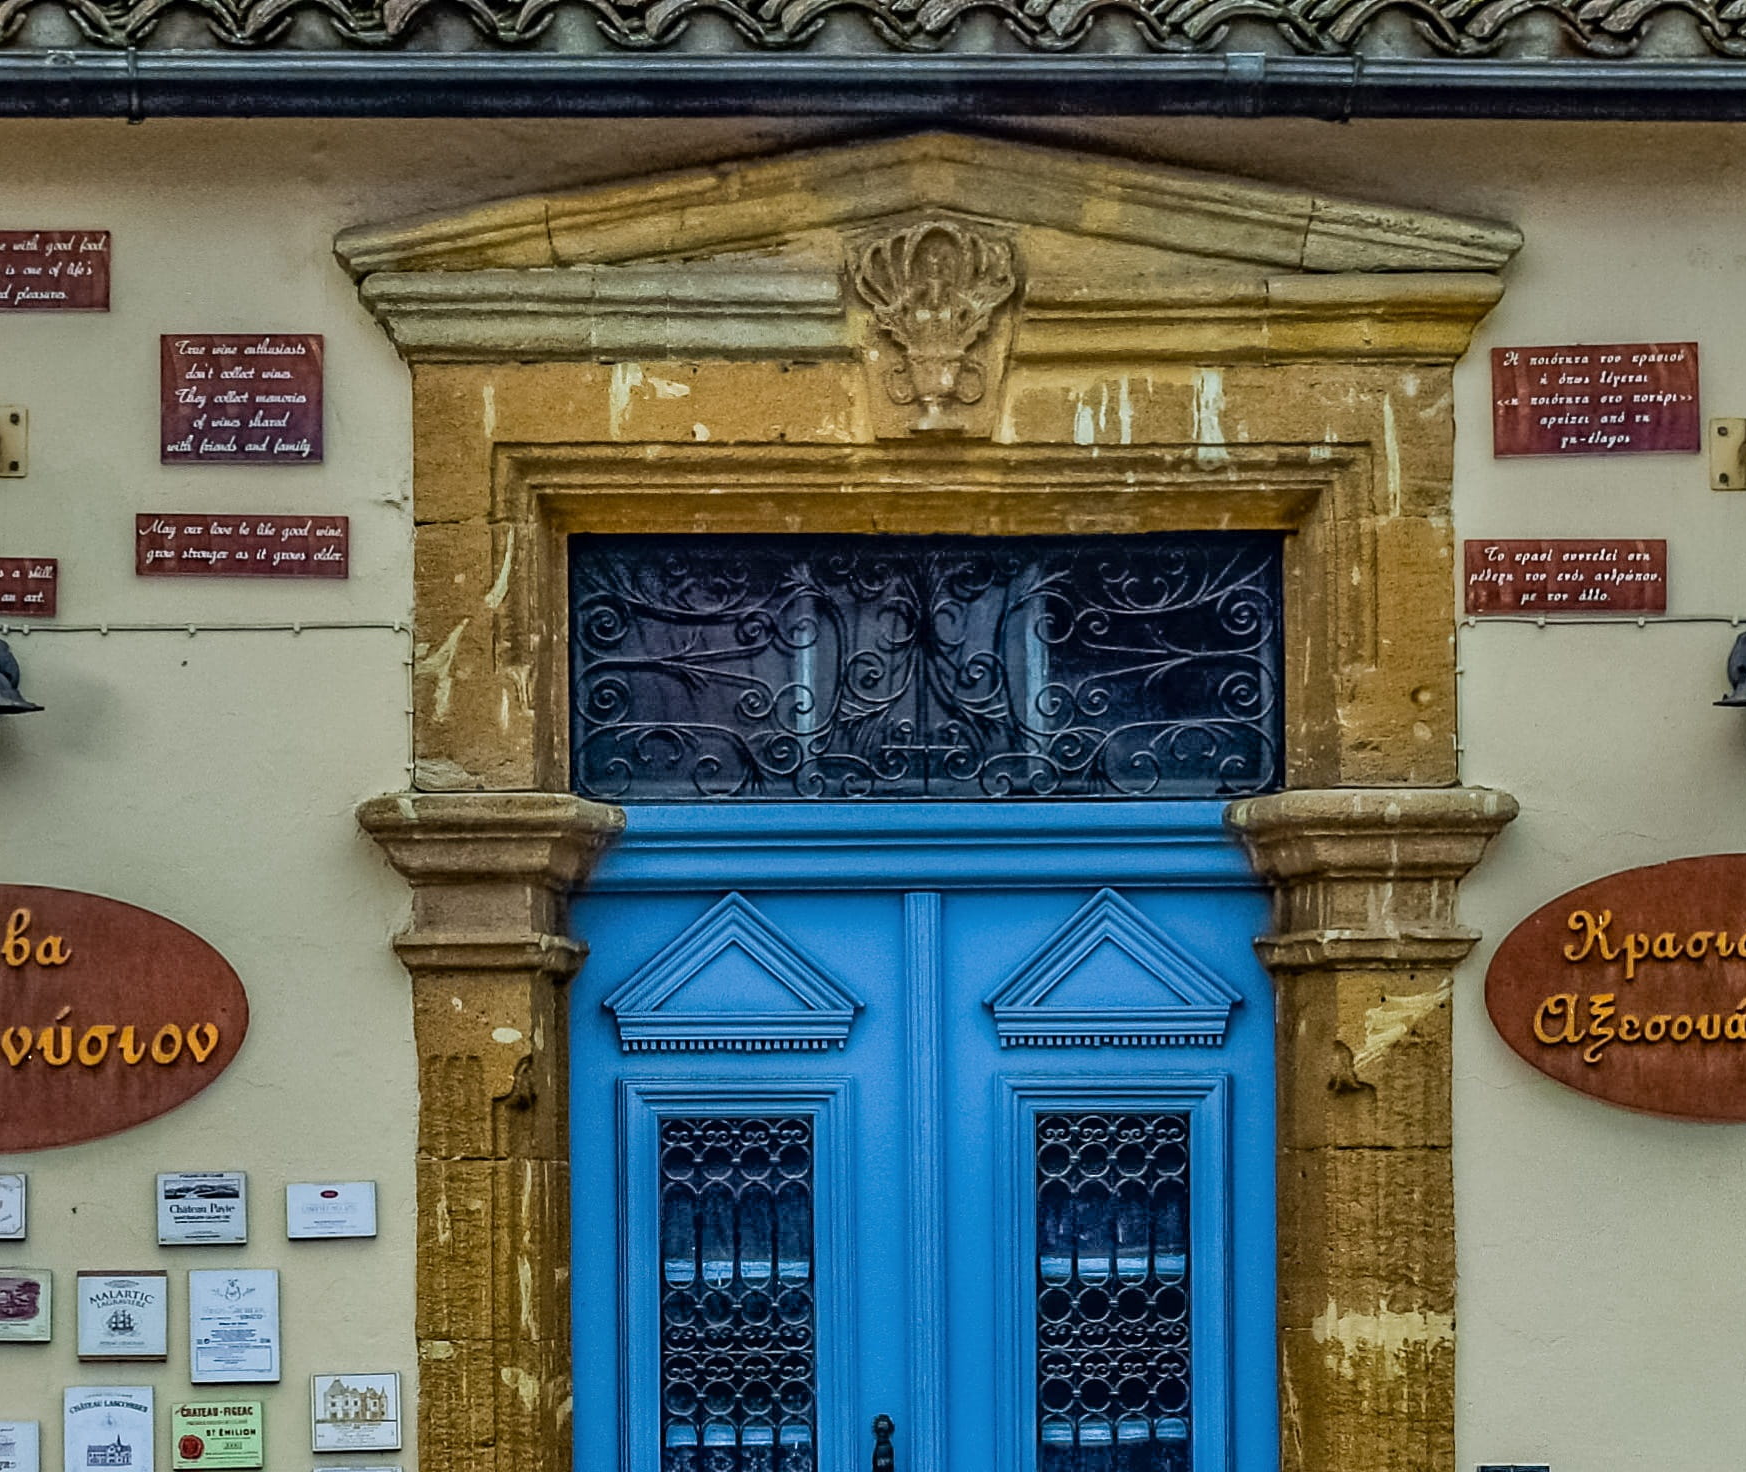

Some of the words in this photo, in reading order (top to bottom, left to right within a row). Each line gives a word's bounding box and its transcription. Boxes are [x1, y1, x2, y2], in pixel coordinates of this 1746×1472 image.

[11, 232, 40, 251] with
[44, 233, 76, 257] good
[4, 263, 16, 275] is
[21, 265, 43, 275] one
[47, 260, 63, 278] of
[173, 338, 206, 355] True
[210, 342, 238, 355] wine
[242, 336, 306, 355] enthusiasts
[1502, 349, 1519, 367] Η
[1528, 351, 1589, 366] ποιότητα
[1599, 354, 1622, 364] του
[1630, 344, 1685, 367] κρασιού
[184, 361, 214, 379] don't
[219, 365, 256, 379] collect
[1538, 371, 1548, 385] ή
[1557, 371, 1590, 385] όπως
[1598, 369, 1648, 388] λέγεται
[173, 384, 207, 409] They
[212, 389, 249, 404] collect
[254, 391, 307, 403] memories
[1529, 391, 1590, 406] ποιότητα
[1599, 393, 1623, 404] στο
[192, 412, 208, 430] of
[210, 415, 241, 428] wines
[247, 408, 290, 428] shared
[1599, 410, 1625, 424] από
[1634, 413, 1651, 423] τη
[165, 433, 194, 452] with
[198, 434, 238, 454] friends
[243, 434, 270, 452] and
[137, 518, 177, 540] May
[182, 525, 204, 535] our
[208, 520, 233, 535] love
[237, 520, 250, 536] be
[255, 521, 276, 536] like
[279, 518, 313, 542] good
[144, 548, 175, 565] grow
[180, 546, 229, 565] stronger
[234, 550, 249, 560] as
[255, 546, 267, 560] it
[271, 550, 306, 566] grows
[1483, 545, 1505, 562] Το
[1513, 547, 1553, 566] κρασί
[1561, 546, 1618, 562] συντελεί
[1626, 552, 1650, 561] στη
[10, 569, 21, 578] a
[1468, 567, 1514, 587] μέθεξη
[1524, 571, 1547, 582] του
[1555, 568, 1585, 582] ενός
[0, 592, 16, 602] an
[22, 590, 45, 603] art.
[1519, 591, 1537, 605] με
[1546, 591, 1569, 602] τον
[1577, 586, 1611, 601] άλλο.
[88, 1289, 156, 1305] MALARTIC
